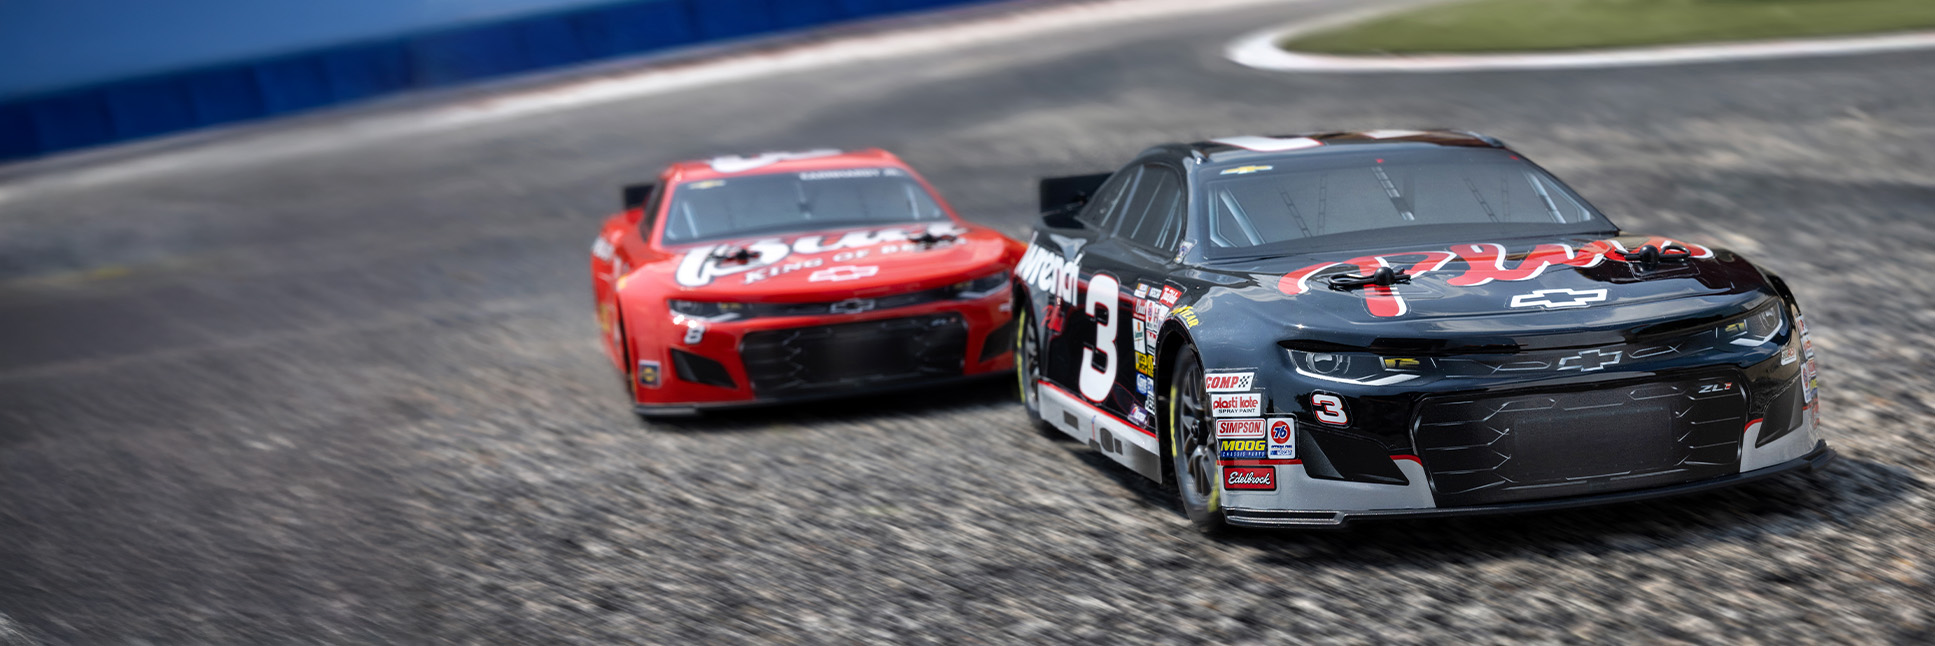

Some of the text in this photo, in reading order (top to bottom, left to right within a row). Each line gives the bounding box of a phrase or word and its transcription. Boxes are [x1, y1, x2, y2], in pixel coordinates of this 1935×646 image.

[744, 257, 823, 284] KING
[832, 250, 869, 262] OF
[1079, 273, 1120, 403] 3
[1206, 376, 1239, 389] COMP
[1213, 396, 1259, 410] plasti kote
[1312, 394, 1348, 424] 3
[1273, 425, 1288, 439] 76
[1221, 440, 1266, 451] MOOG
[1228, 471, 1271, 485] Edelbrock
